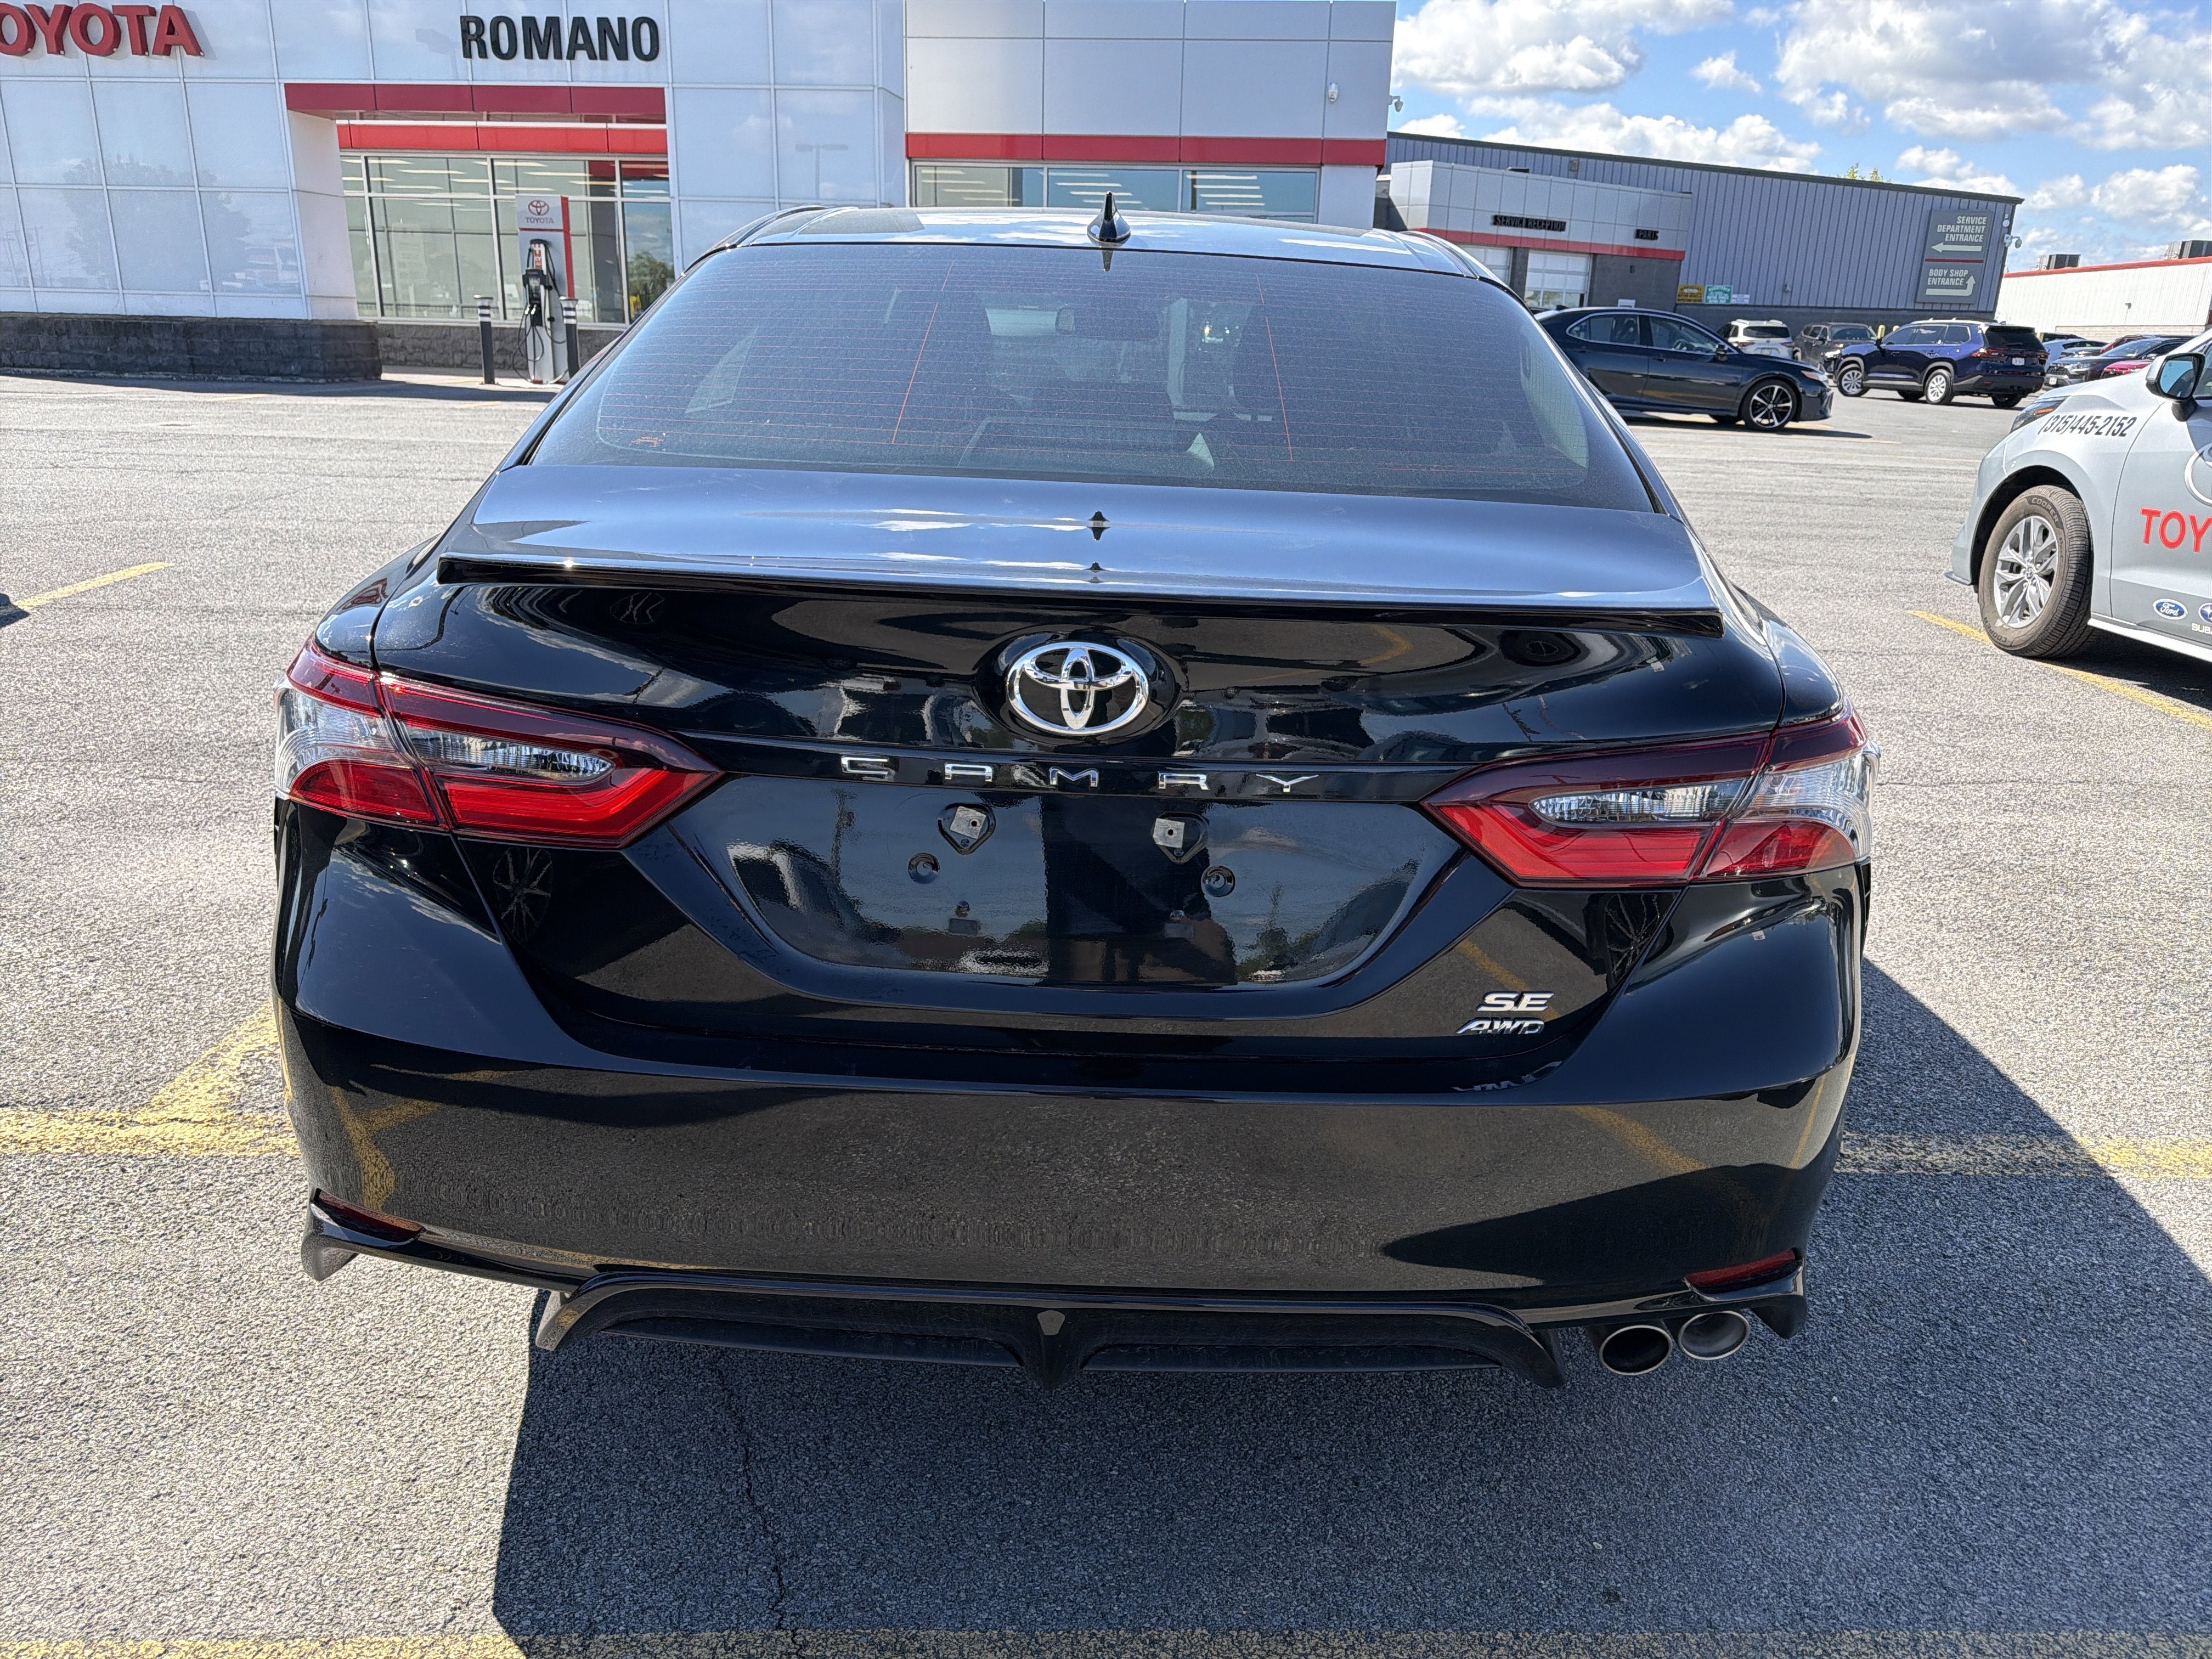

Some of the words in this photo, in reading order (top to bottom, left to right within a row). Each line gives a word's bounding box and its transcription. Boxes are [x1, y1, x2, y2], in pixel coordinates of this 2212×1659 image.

[460, 15, 659, 61] ROMANO
[1527, 218, 1566, 232] RECEPTION
[1956, 216, 1987, 225] SERVICE
[1635, 229, 1659, 241] PARTS
[1937, 224, 1985, 233] DEPARTMENT
[1945, 234, 1984, 242] ENTRANCE
[1929, 268, 1948, 276] BODY
[1949, 269, 1968, 277] SHOP
[1927, 277, 1964, 286] ENTRANCE
[2038, 415, 2137, 437] (315)445-2152
[2031, 496, 2059, 523] COOPER
[2159, 602, 2179, 616] Ford
[1984, 617, 2008, 643] COOPER
[2191, 623, 2212, 635] SUB
[841, 755, 1320, 793] CAMRY
[1476, 991, 1555, 1012] SE
[1455, 1017, 1545, 1035] AWD
